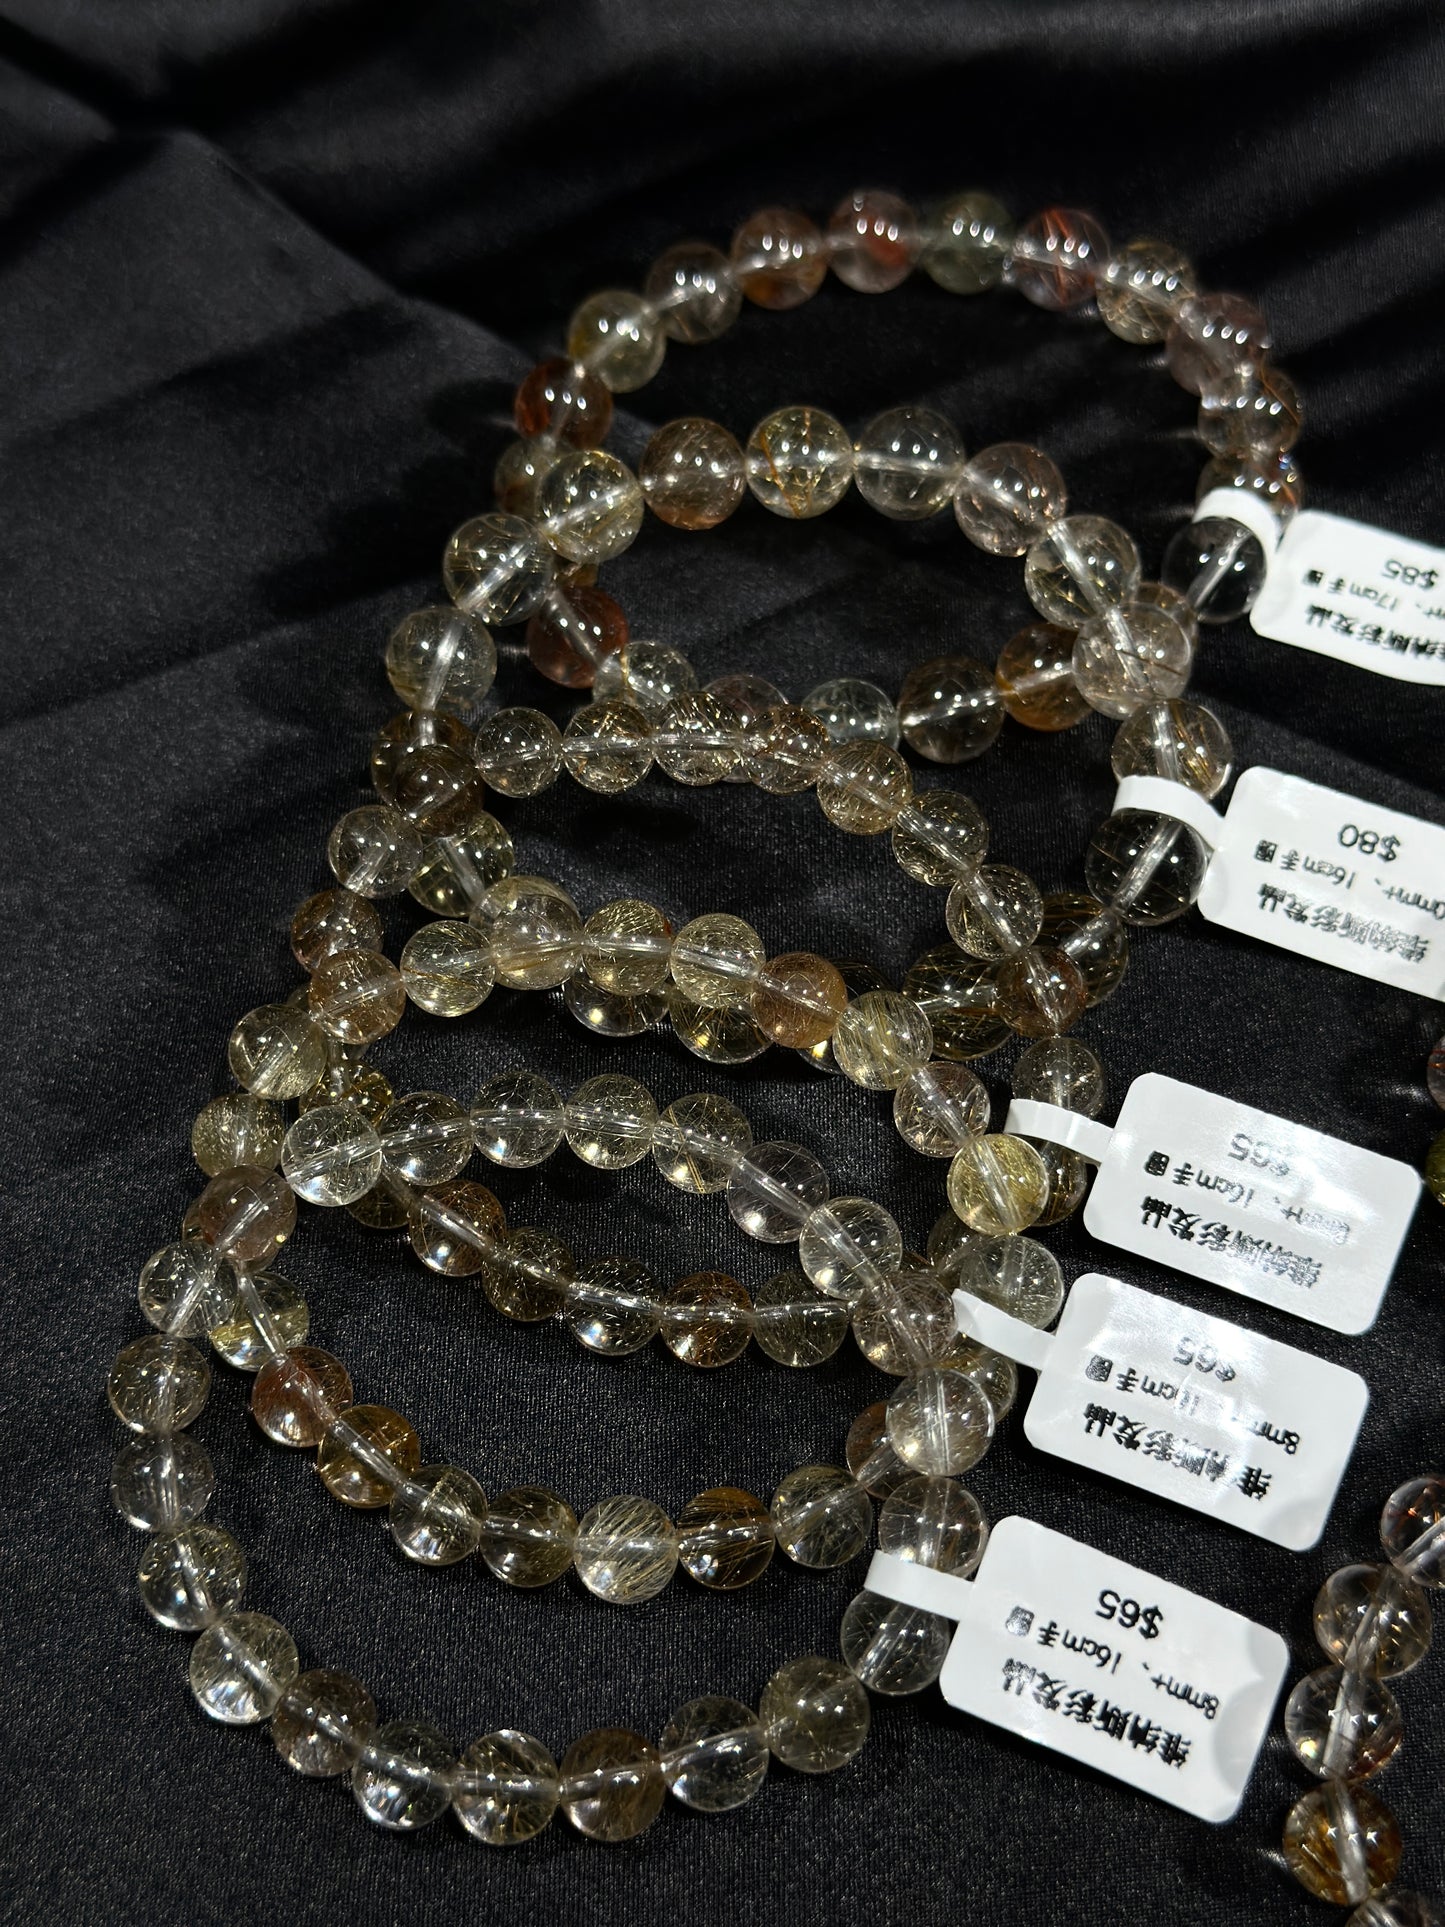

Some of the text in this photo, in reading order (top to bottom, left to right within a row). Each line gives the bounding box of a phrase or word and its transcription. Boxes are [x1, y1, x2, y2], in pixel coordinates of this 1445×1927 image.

[1382, 558, 1439, 591] $85
[1338, 823, 1400, 862] $80
[1095, 1588, 1163, 1640] $65
[1001, 1658, 1192, 1769] 维纳斯彩发晶
